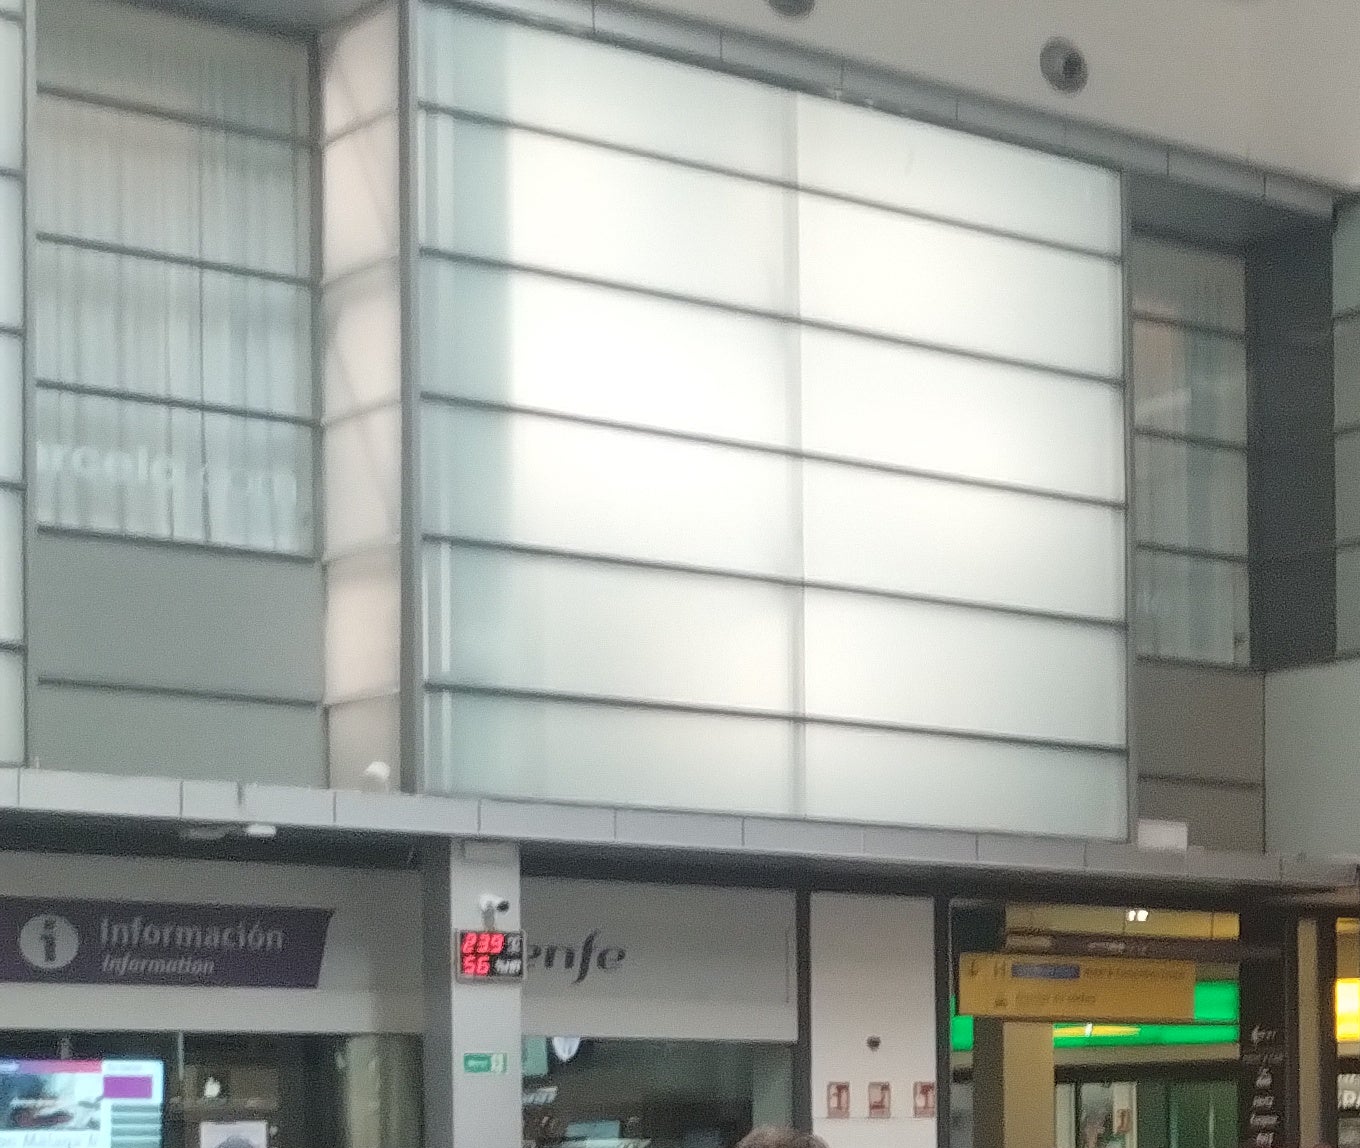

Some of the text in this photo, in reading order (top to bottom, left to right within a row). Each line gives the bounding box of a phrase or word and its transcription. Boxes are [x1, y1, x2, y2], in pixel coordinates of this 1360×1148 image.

[101, 915, 285, 953] Información
[102, 955, 216, 976] Information
[462, 955, 491, 976] 56
[527, 928, 627, 985] enfe
